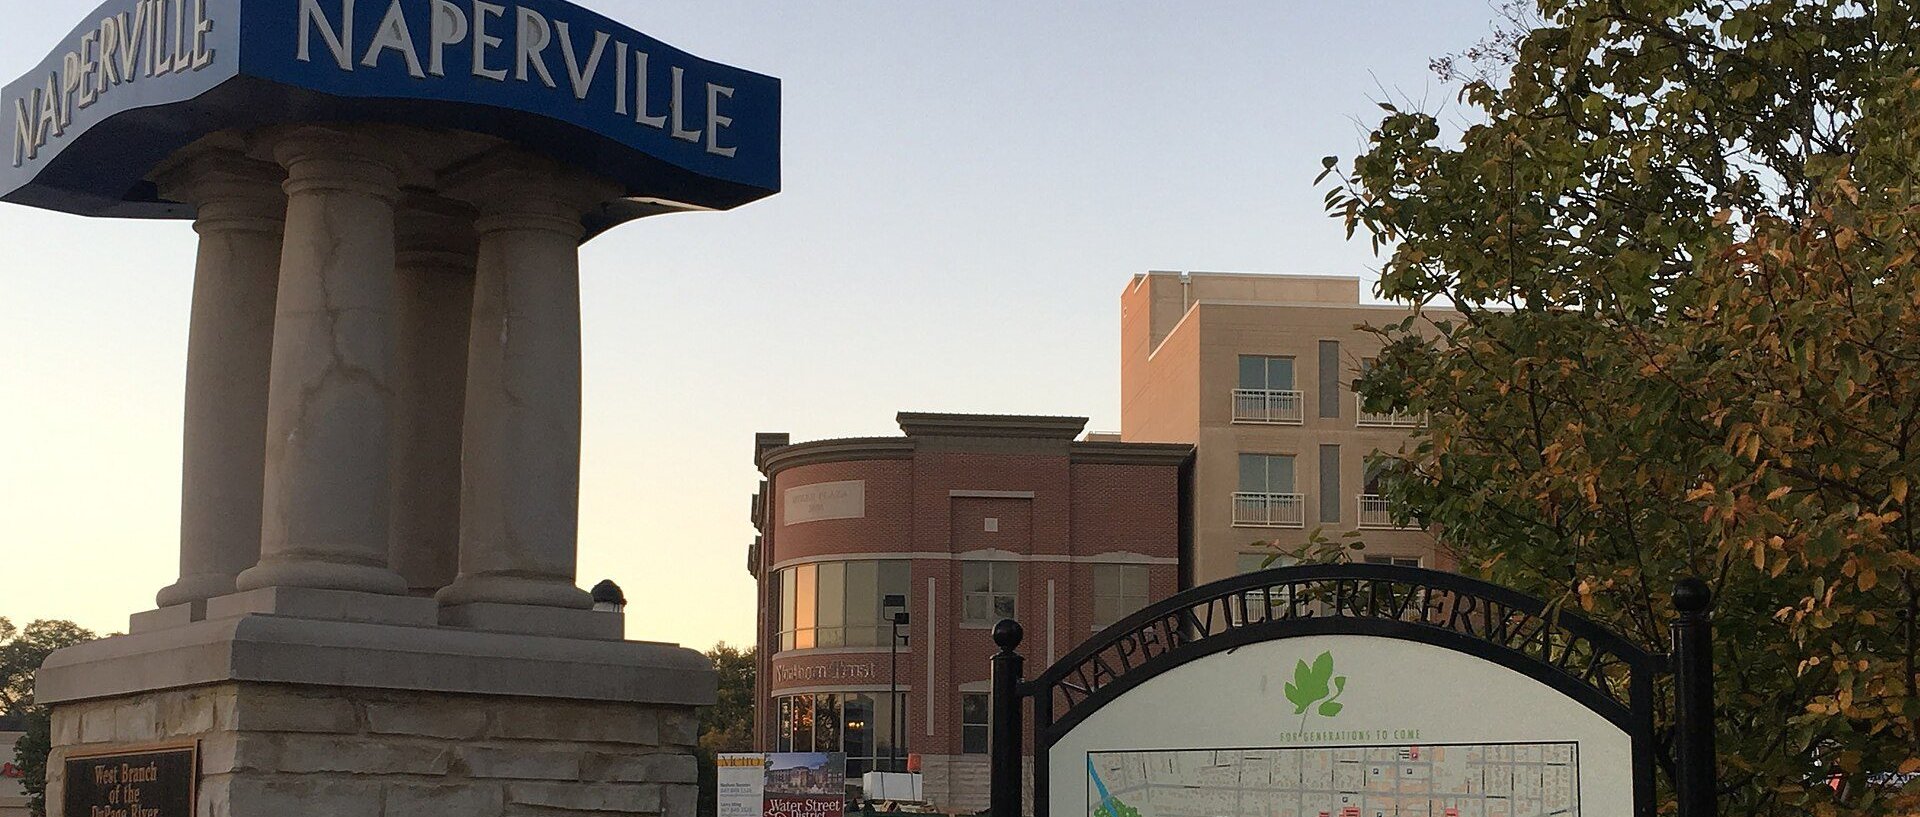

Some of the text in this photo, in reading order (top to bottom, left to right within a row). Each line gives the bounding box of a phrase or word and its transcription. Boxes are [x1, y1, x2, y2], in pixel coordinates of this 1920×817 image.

[12, 0, 215, 168] NAPERVILLE
[296, 0, 738, 158] NAPERVILLE
[1055, 583, 1314, 709] NAPERVILLE
[1280, 729, 1420, 742] FOR GENERATIONS TO COME
[95, 761, 158, 784] West Branch
[109, 783, 140, 804] of the
[769, 799, 841, 812] Water Street
